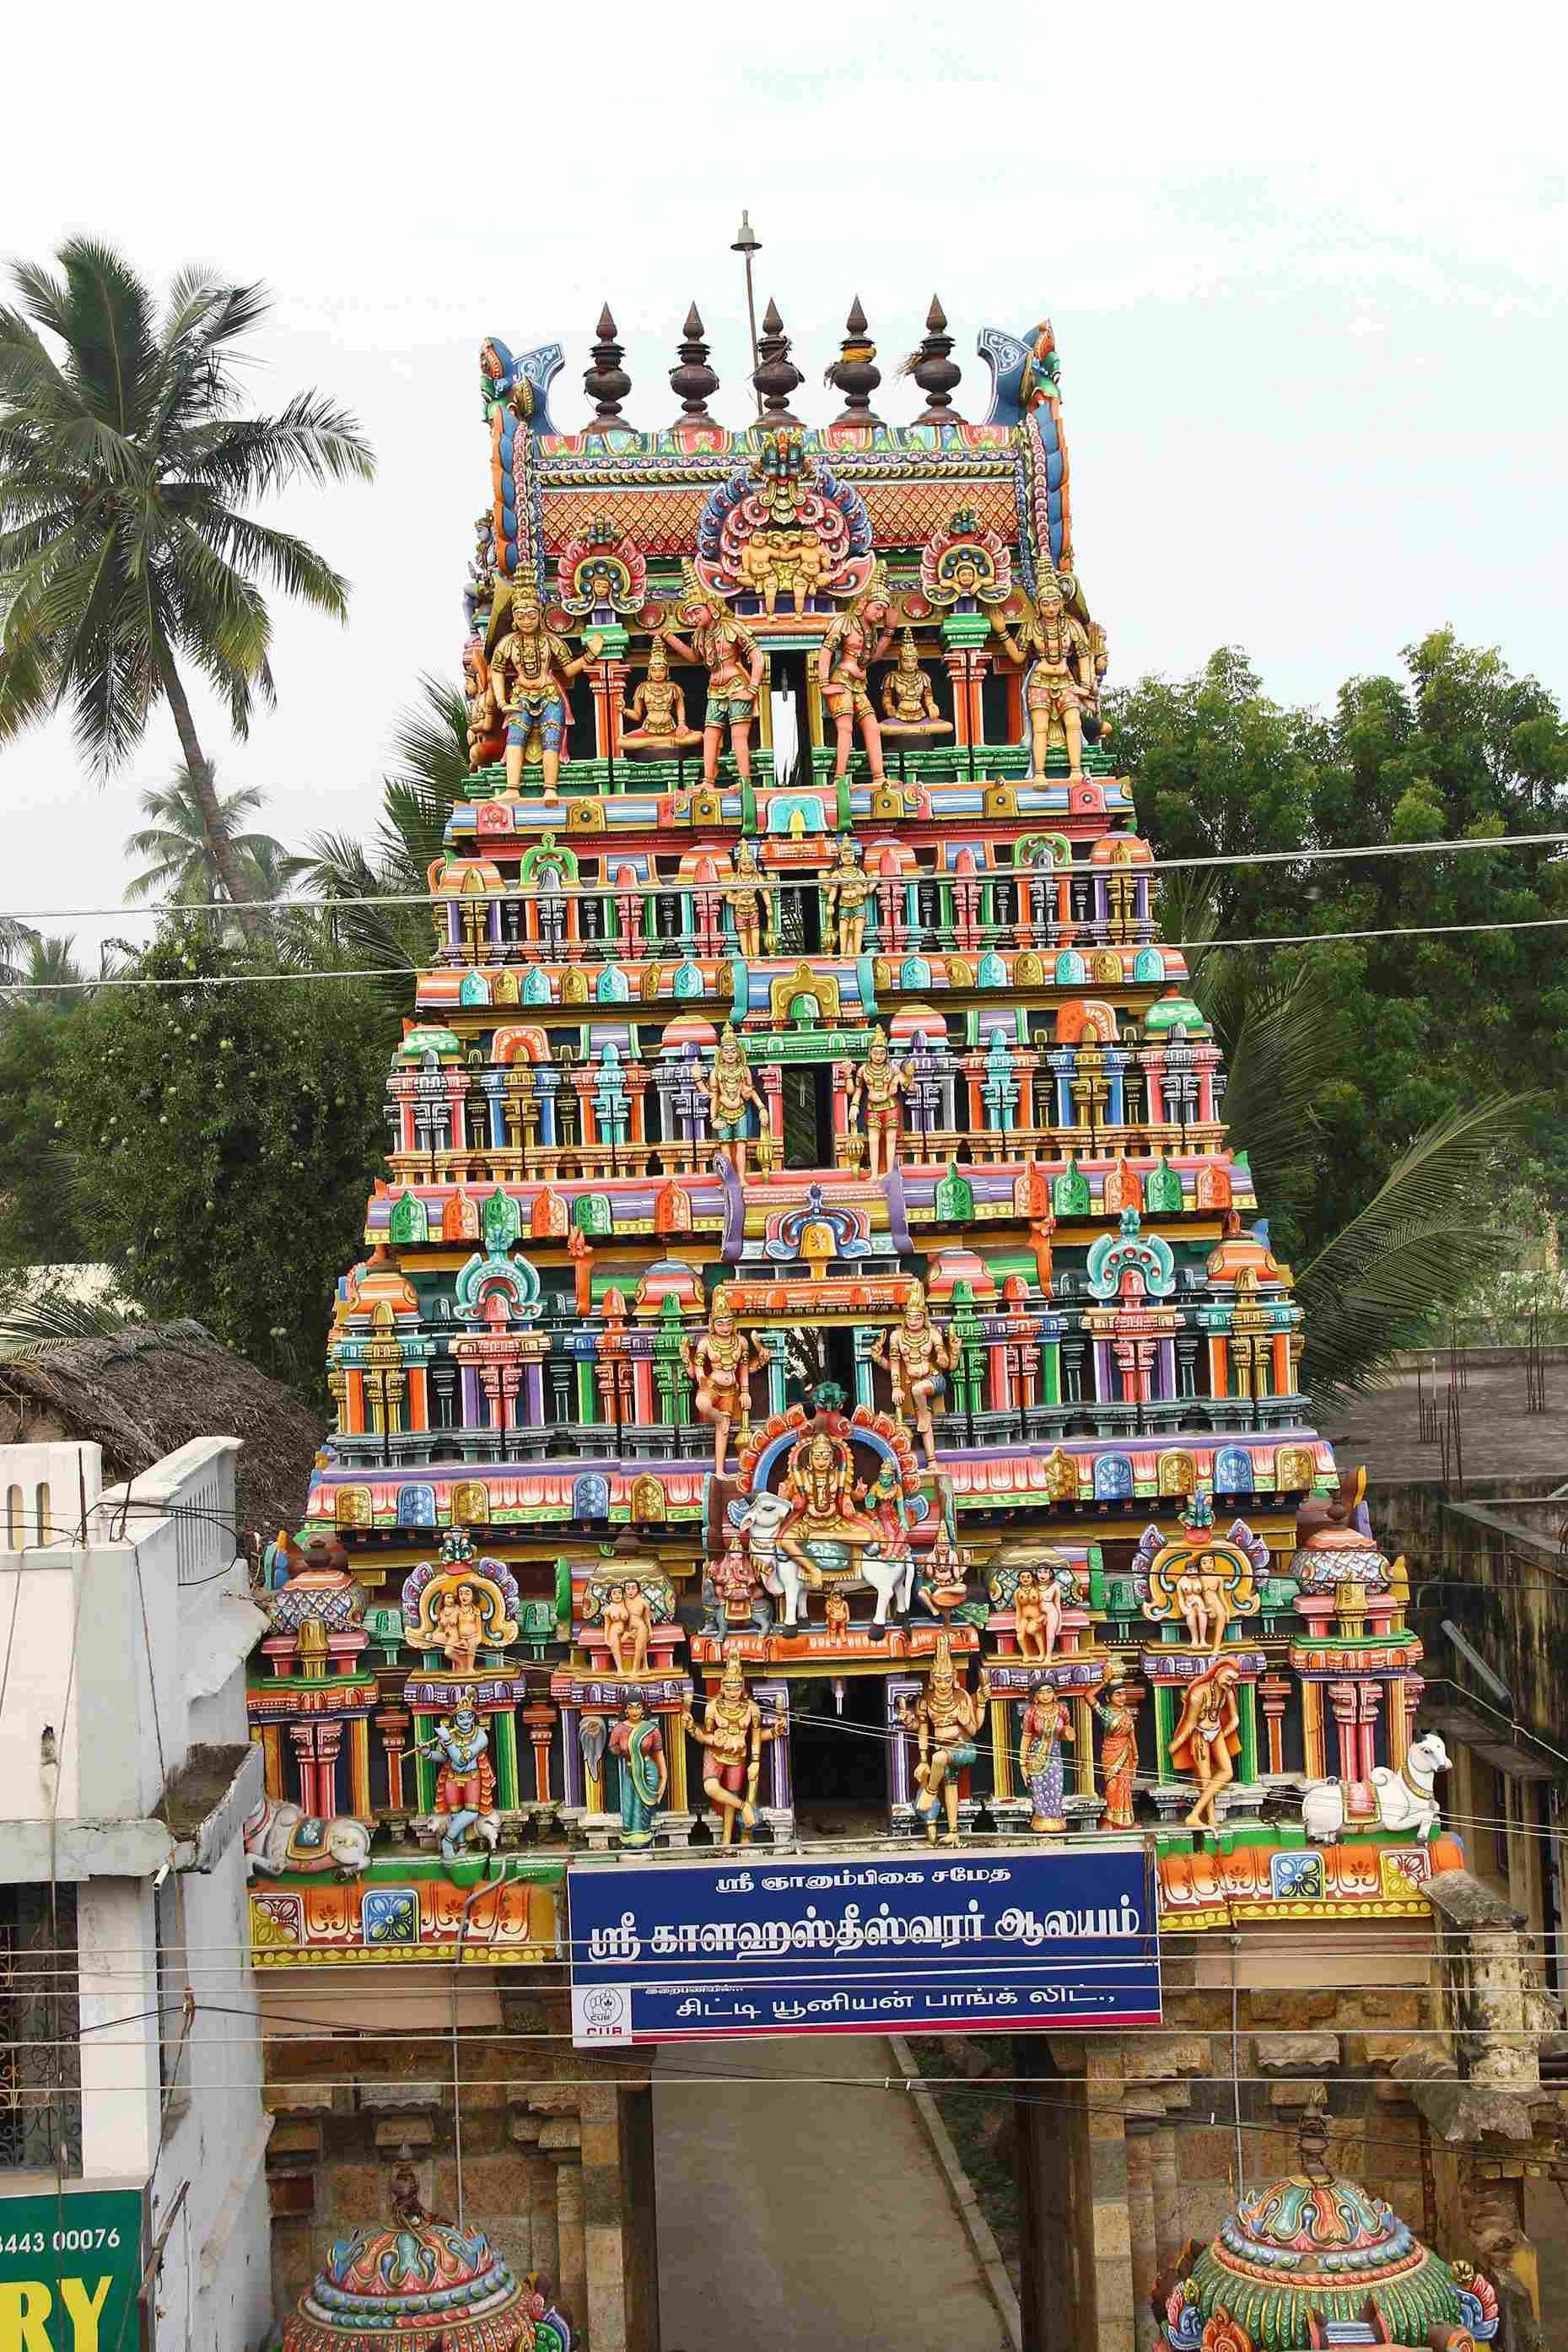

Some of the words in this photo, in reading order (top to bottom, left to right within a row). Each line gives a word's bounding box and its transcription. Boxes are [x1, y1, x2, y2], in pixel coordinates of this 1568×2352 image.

[931, 1866, 1012, 1884] சமேத
[995, 1893, 1140, 1946] ஆலயம்
[676, 1997, 762, 2020] சிட்டி
[772, 1990, 915, 2019] யூனியன்
[924, 1987, 1019, 2008] பாங்க்
[52, 2227, 121, 2252] 00076
